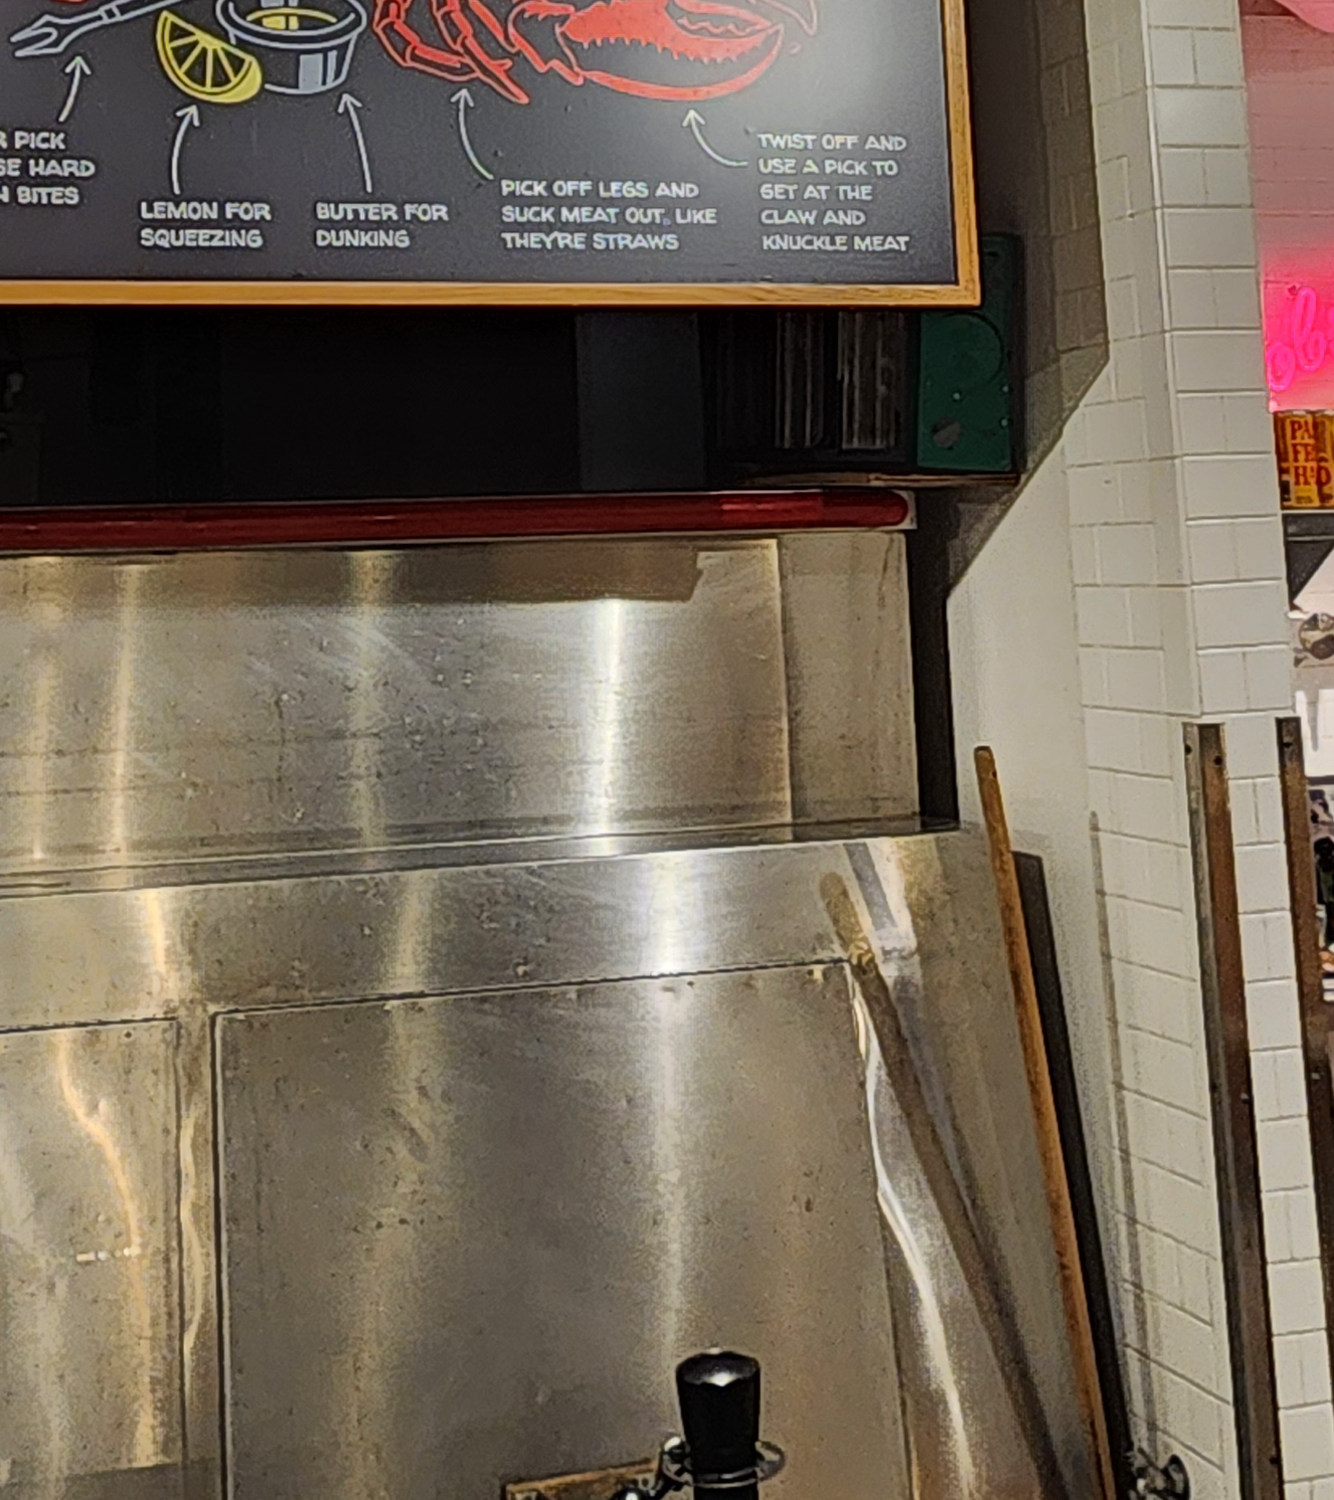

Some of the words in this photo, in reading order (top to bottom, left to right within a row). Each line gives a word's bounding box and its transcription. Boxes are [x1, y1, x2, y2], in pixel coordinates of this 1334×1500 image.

[14, 131, 66, 150] PICK
[757, 133, 816, 150] TWIST
[821, 134, 858, 151] OFF
[864, 135, 907, 152] AND
[28, 159, 95, 178] HARD
[758, 158, 795, 175] USE
[801, 160, 819, 174] A
[825, 159, 867, 176] PICK
[873, 159, 899, 176] TO
[17, 184, 80, 205] BITES
[501, 180, 547, 197] PICK
[552, 181, 593, 197] OFF
[598, 181, 649, 198] LEGS
[654, 182, 699, 198] AND
[760, 184, 799, 200] GET
[804, 184, 830, 200] AT
[835, 184, 873, 201] THE
[141, 200, 219, 220] LEMON
[224, 202, 271, 221] FOR
[316, 202, 399, 222] BUTTER
[404, 203, 449, 222] FOR
[501, 206, 554, 223] SUCK
[560, 206, 618, 224] MEAT
[676, 208, 717, 225] LIKE
[761, 210, 817, 226] CLAW
[822, 210, 865, 226] AND
[140, 228, 264, 248] SQUEEZING
[316, 229, 410, 248] DUNKING
[592, 233, 679, 251] STRAWS
[762, 234, 847, 252] KNUCKLE
[853, 235, 910, 252] MEAT
